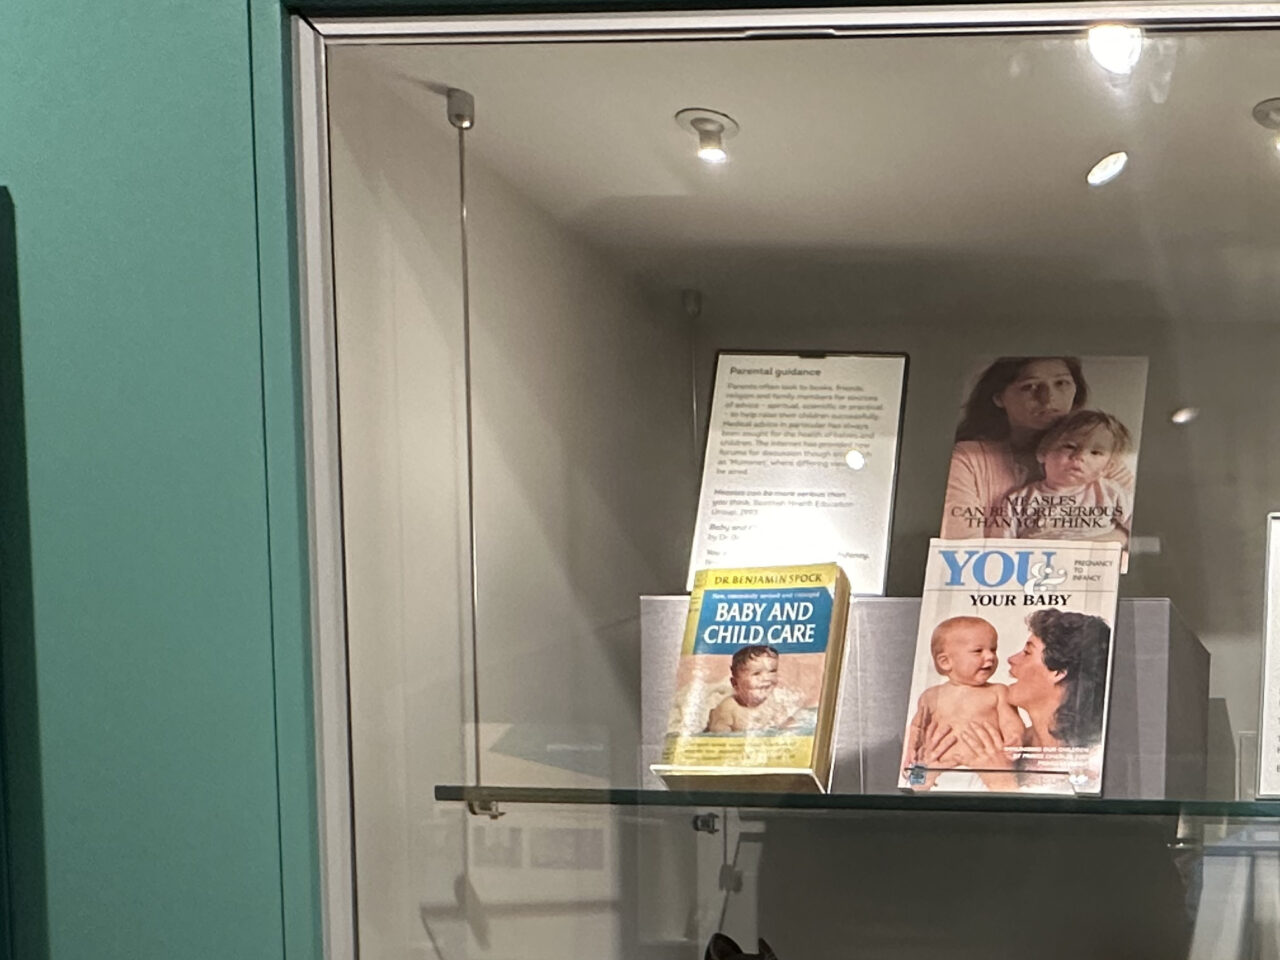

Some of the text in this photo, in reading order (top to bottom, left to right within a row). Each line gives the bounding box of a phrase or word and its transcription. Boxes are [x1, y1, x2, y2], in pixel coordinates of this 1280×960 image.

[730, 366, 821, 378] Parental guidance
[1006, 496, 1076, 506] MEASLES
[952, 507, 986, 517] CAN
[1011, 507, 1057, 517] MORE
[1060, 506, 1123, 517] SERIOUS
[966, 518, 1012, 528] THAN
[1014, 518, 1048, 528] YOU
[938, 550, 1057, 588] YOU
[714, 573, 822, 585] DR BENJAMIN SPOCK
[969, 594, 1072, 606] YOUR BABY
[716, 602, 814, 622] BABY AND
[704, 624, 816, 644] CHILD CARE
